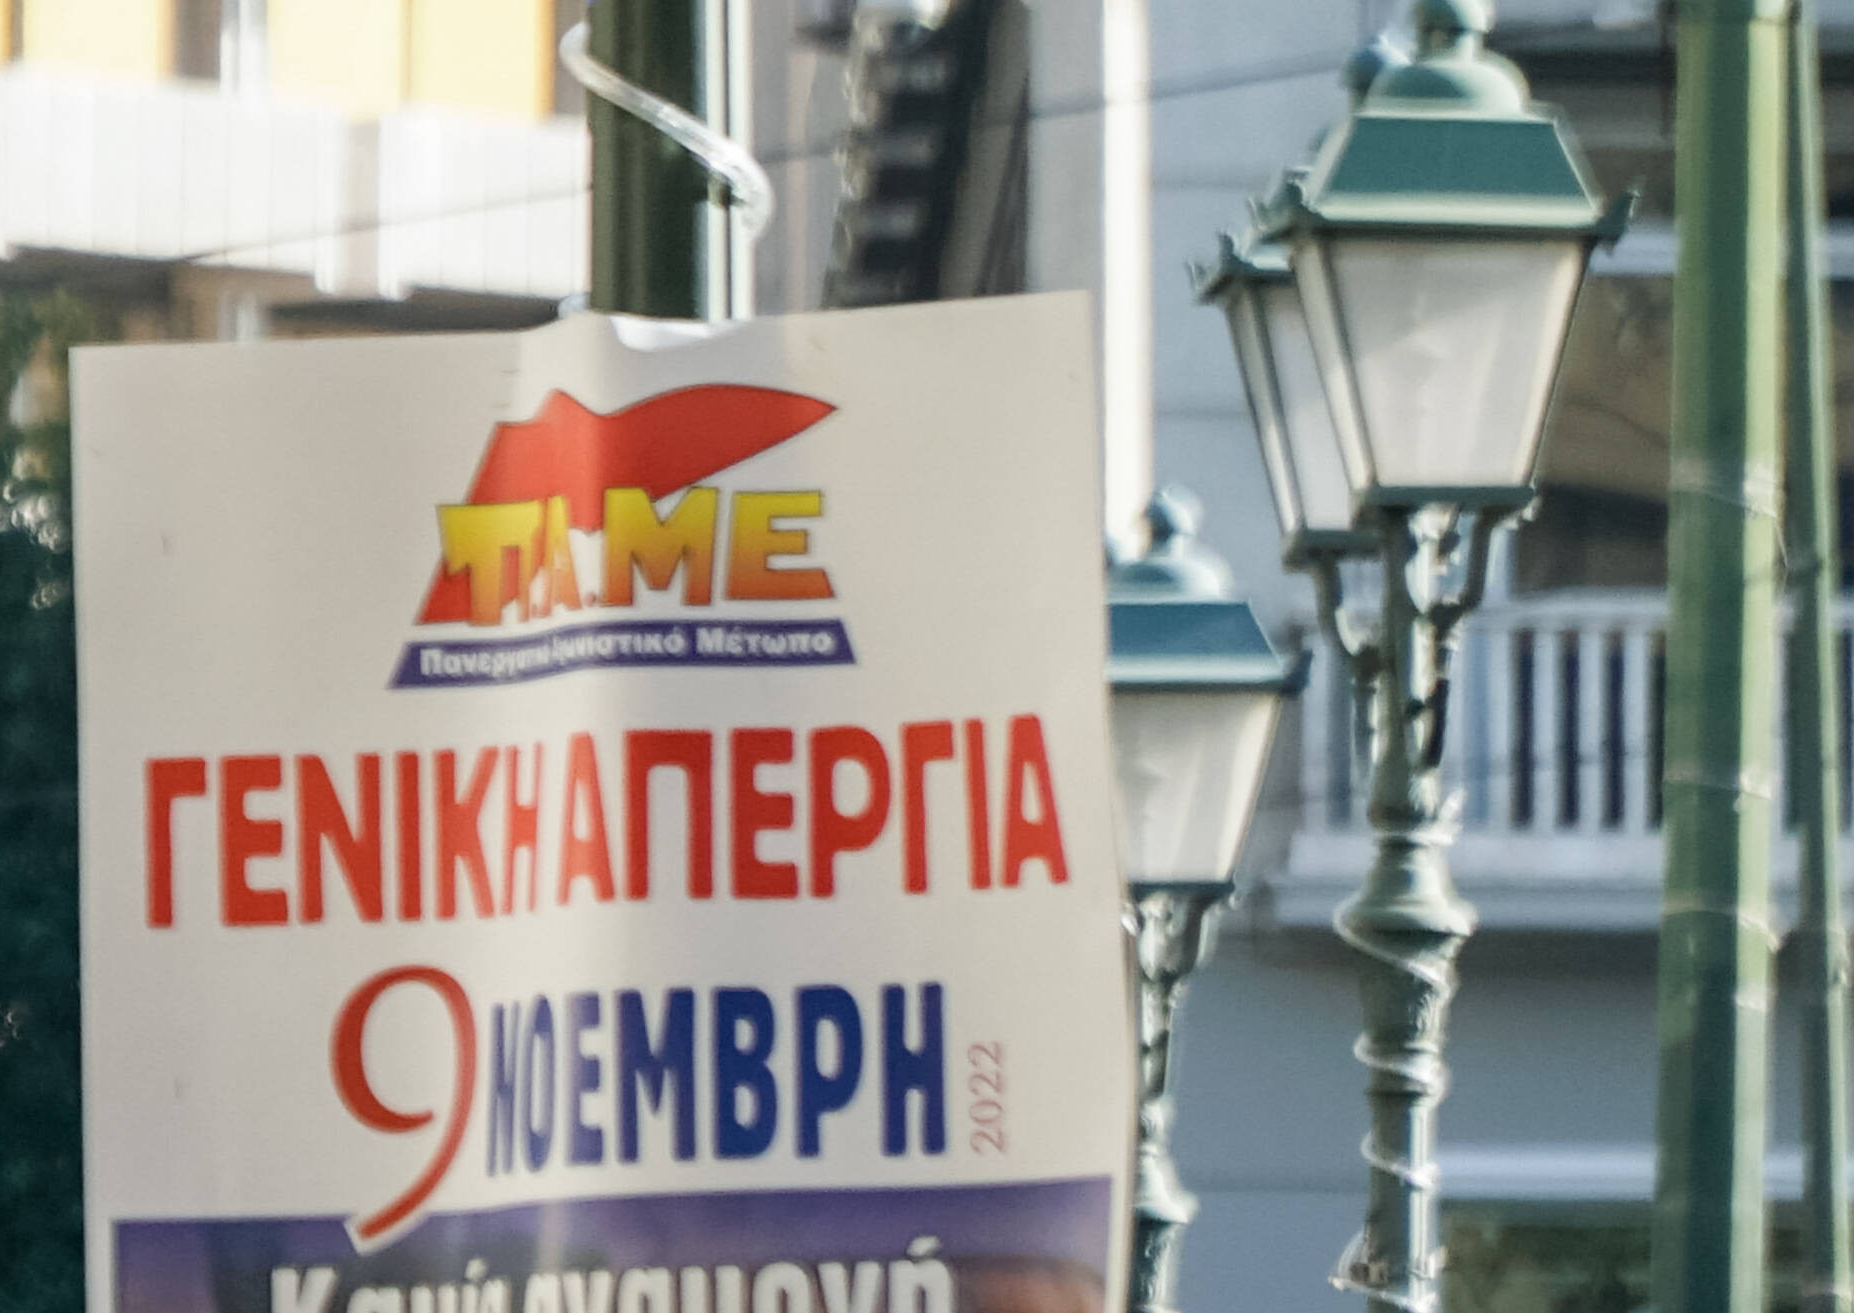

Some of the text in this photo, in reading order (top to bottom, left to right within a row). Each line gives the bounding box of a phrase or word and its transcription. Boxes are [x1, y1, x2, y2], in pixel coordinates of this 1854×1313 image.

[695, 625, 834, 658] Μέτωπο
[143, 711, 1072, 928] ΓΕΝΙΚΗ ΑΠΕΡΓΙΑ
[328, 964, 950, 1244] 9 ΝΟΕΜΒΡΗ
